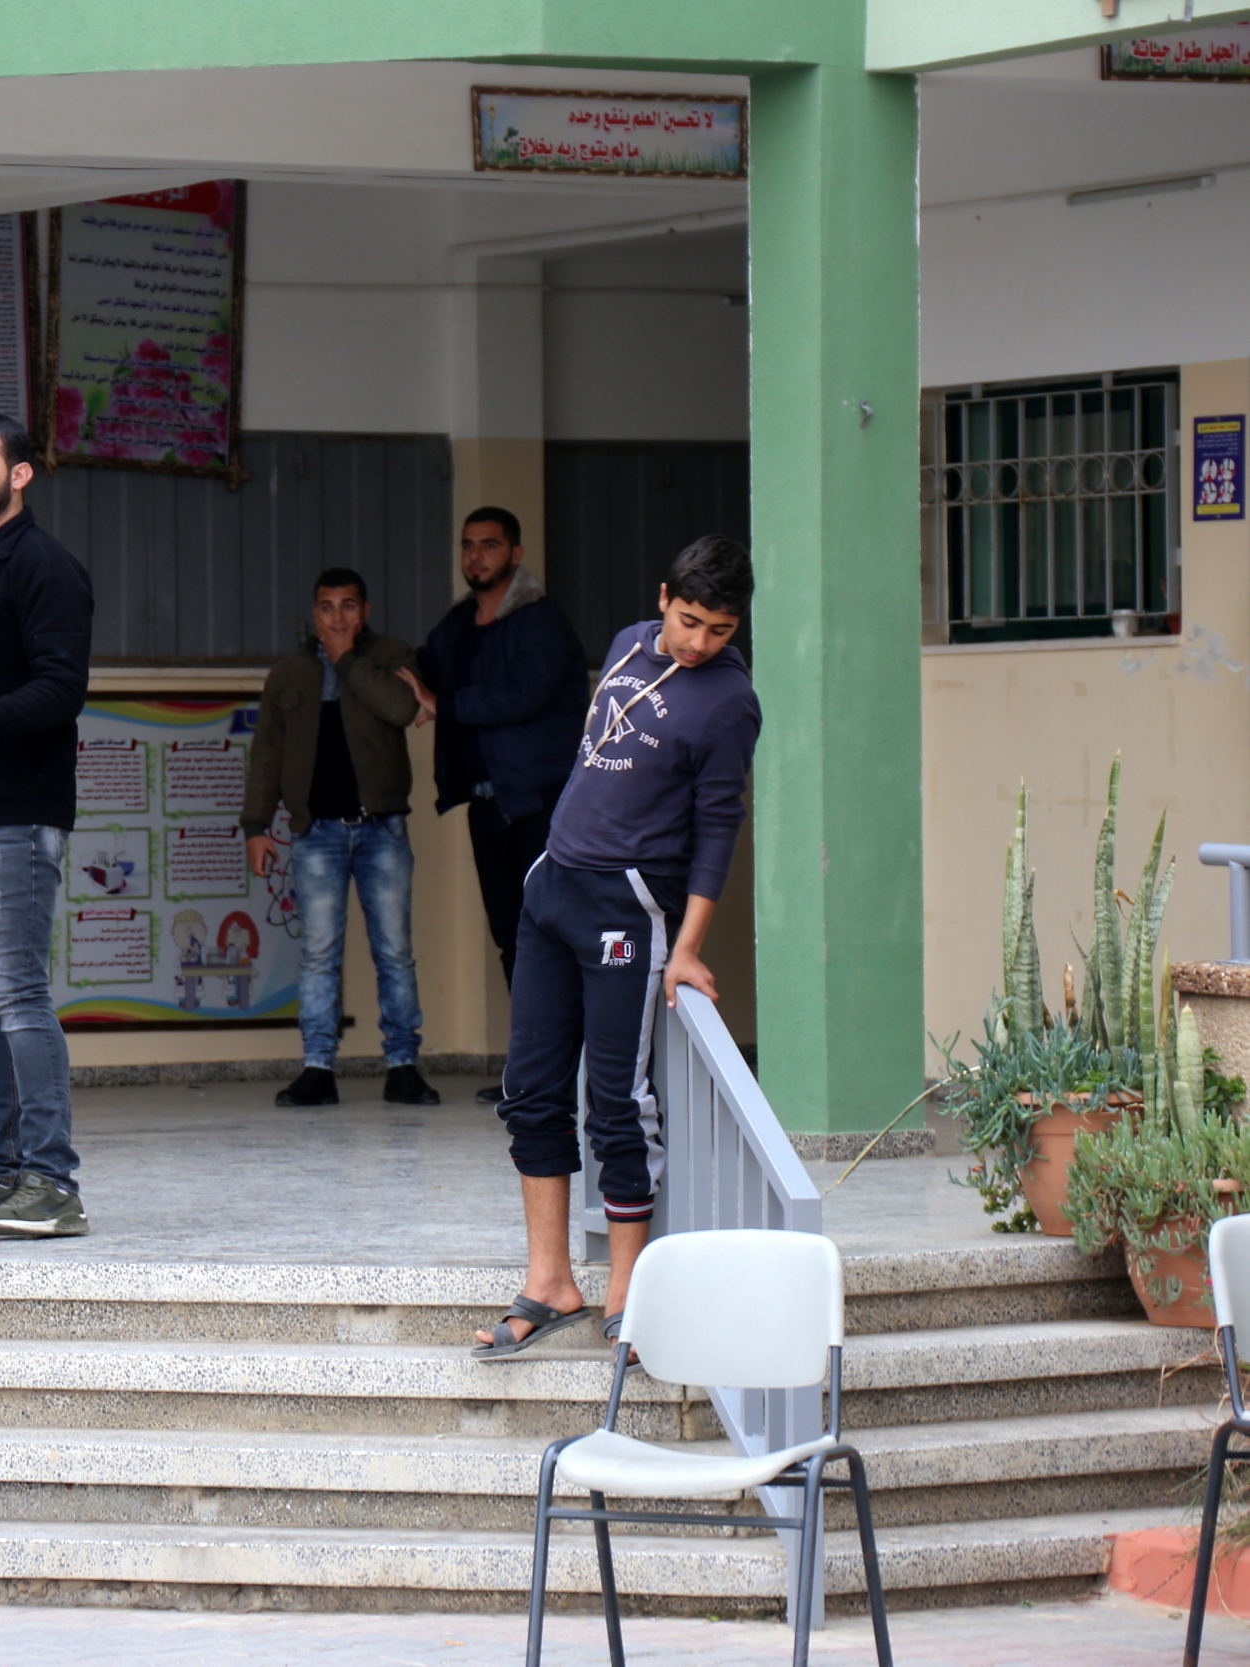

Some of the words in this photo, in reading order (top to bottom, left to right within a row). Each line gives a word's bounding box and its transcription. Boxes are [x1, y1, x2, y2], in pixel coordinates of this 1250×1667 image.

[1174, 41, 1202, 63] طول
[568, 109, 601, 130] وحده
[603, 107, 630, 132] ينفع
[632, 110, 662, 127] العلم
[663, 109, 701, 132] تحسبن
[704, 111, 714, 128] لا
[557, 141, 579, 161] ربه
[580, 140, 610, 163] يتوج
[624, 141, 640, 158] ما
[604, 675, 646, 691] PACIFIC
[644, 686, 668, 719] IRLS
[638, 732, 661, 749] 1991
[582, 734, 633, 771] COLECTION
